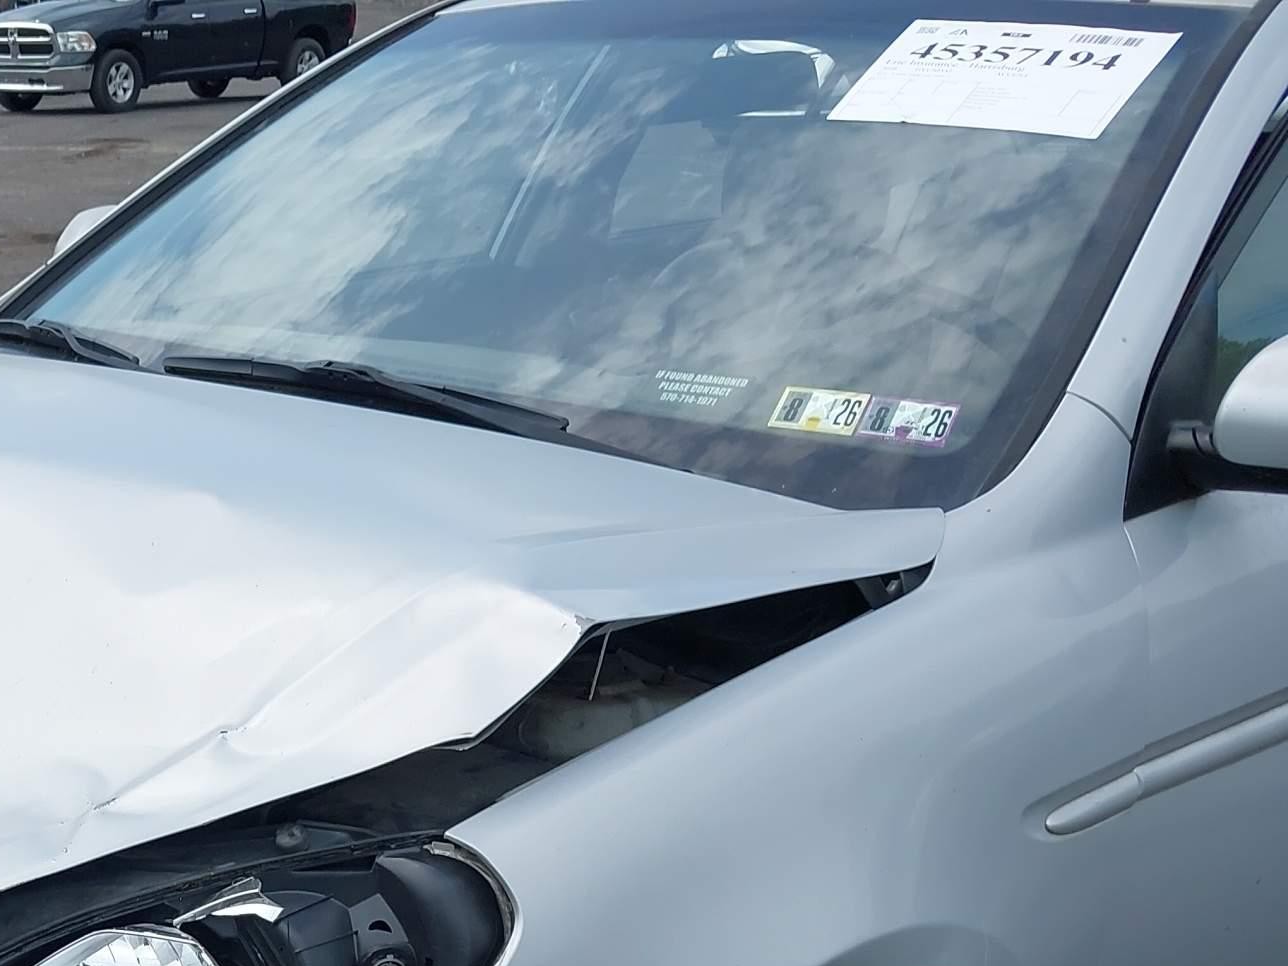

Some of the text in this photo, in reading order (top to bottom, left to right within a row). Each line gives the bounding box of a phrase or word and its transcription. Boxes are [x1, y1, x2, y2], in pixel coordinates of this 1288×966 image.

[910, 42, 1122, 71] 45357194
[658, 381, 732, 397] PLEASE CONTACT
[664, 370, 695, 381] FOUND
[693, 374, 749, 388] ABANDONED
[784, 398, 863, 427] 8 26
[870, 406, 953, 438] 8 26
